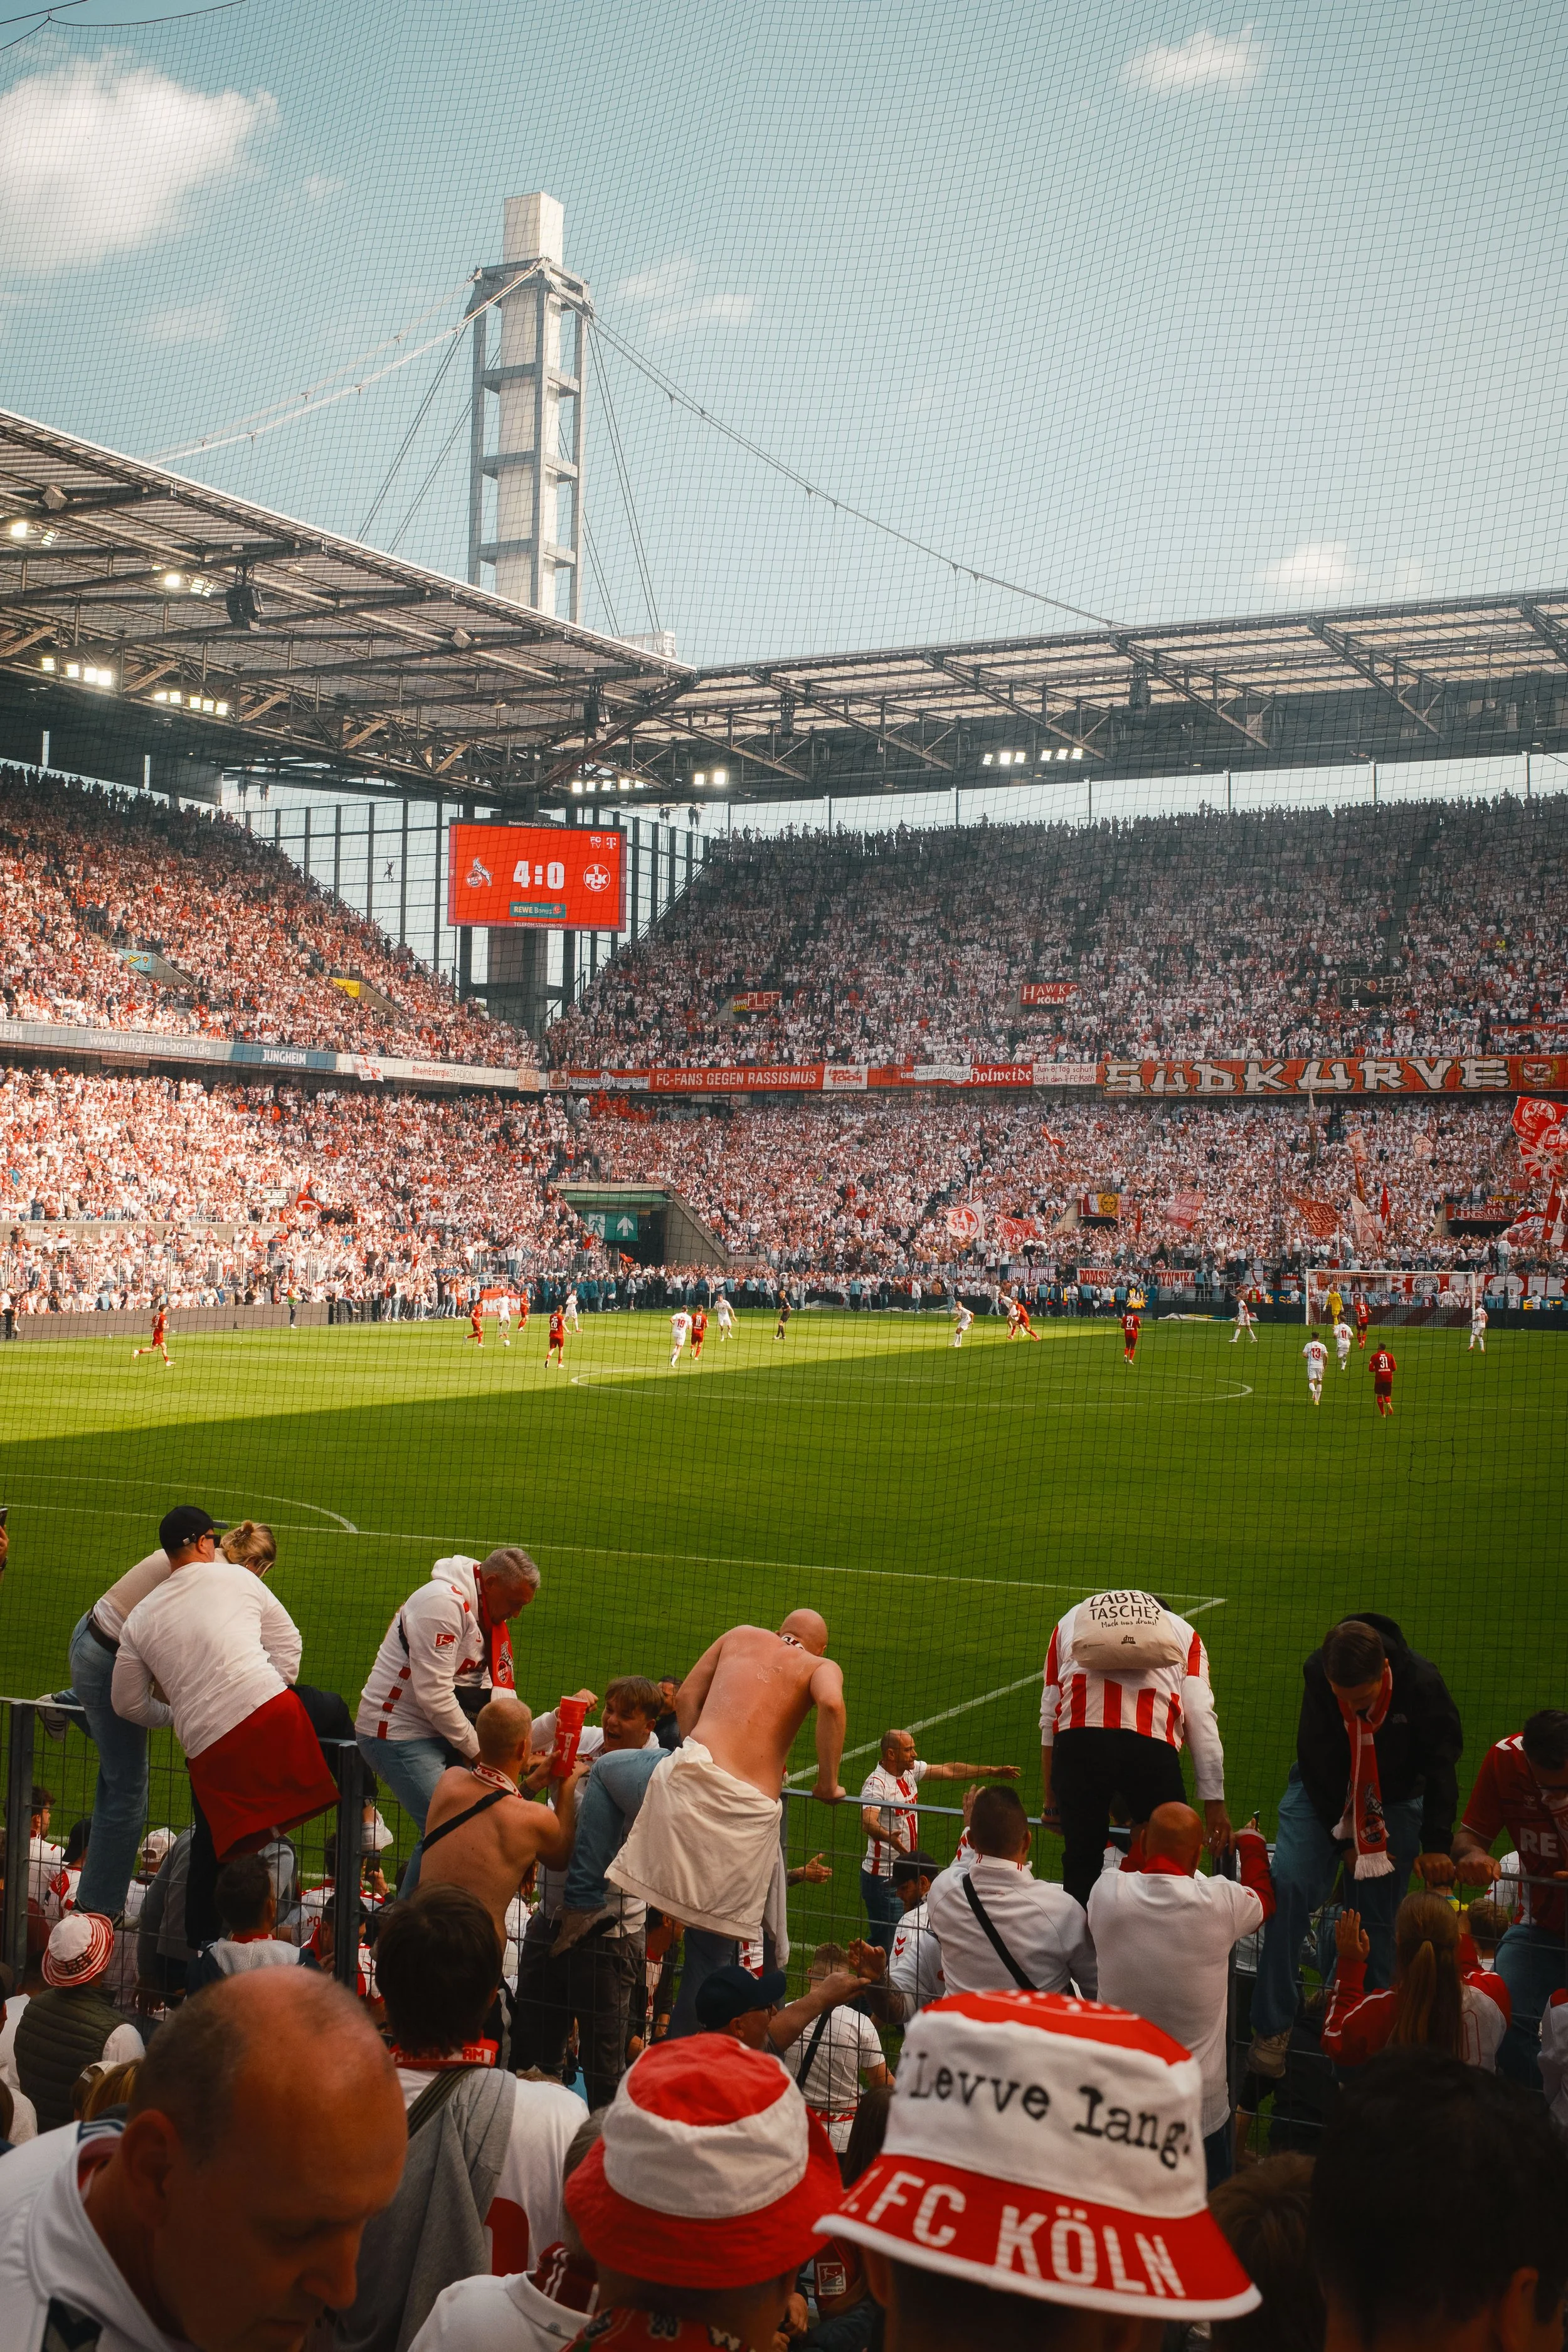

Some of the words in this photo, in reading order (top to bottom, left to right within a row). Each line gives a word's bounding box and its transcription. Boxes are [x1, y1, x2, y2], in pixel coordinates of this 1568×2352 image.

[513, 861, 564, 889] 4:0
[1037, 995, 1064, 1004] KÖLN
[90, 1034, 211, 1055] www.jungheim-bonn.de
[262, 1049, 306, 1065] JUNGHEIM
[412, 1065, 475, 1080] RheinEnergieSTADION
[970, 1067, 1032, 1084] Holweide
[1059, 1066, 1070, 1074] Tag
[1104, 1058, 1512, 1093] SÜDKURVE
[656, 1073, 703, 1086] FC-FANS
[707, 1072, 744, 1086] GEGEN
[748, 1071, 817, 1085] RASSISMUS
[1035, 1074, 1049, 1083] Gott
[1051, 1074, 1062, 1083] den
[1069, 1074, 1078, 1083] FC
[1079, 1074, 1094, 1083] Köln
[551, 1318, 558, 1328] 26
[677, 1318, 686, 1328] 19
[696, 1316, 702, 1327] 10
[1126, 1318, 1134, 1328] 27
[1340, 1330, 1347, 1339] 11
[1311, 1347, 1321, 1359] 13
[1379, 1356, 1388, 1369] 31
[1089, 1591, 1155, 1608] LABER
[1089, 1605, 1160, 1620] TASCHE?
[1101, 1619, 1118, 1628] Mach
[1135, 1617, 1157, 1626] draus!
[462, 2048, 484, 2062] AM
[909, 2051, 1051, 2121] Levve
[995, 2205, 1186, 2299] KÖLN
[835, 2275, 842, 2286] 2
